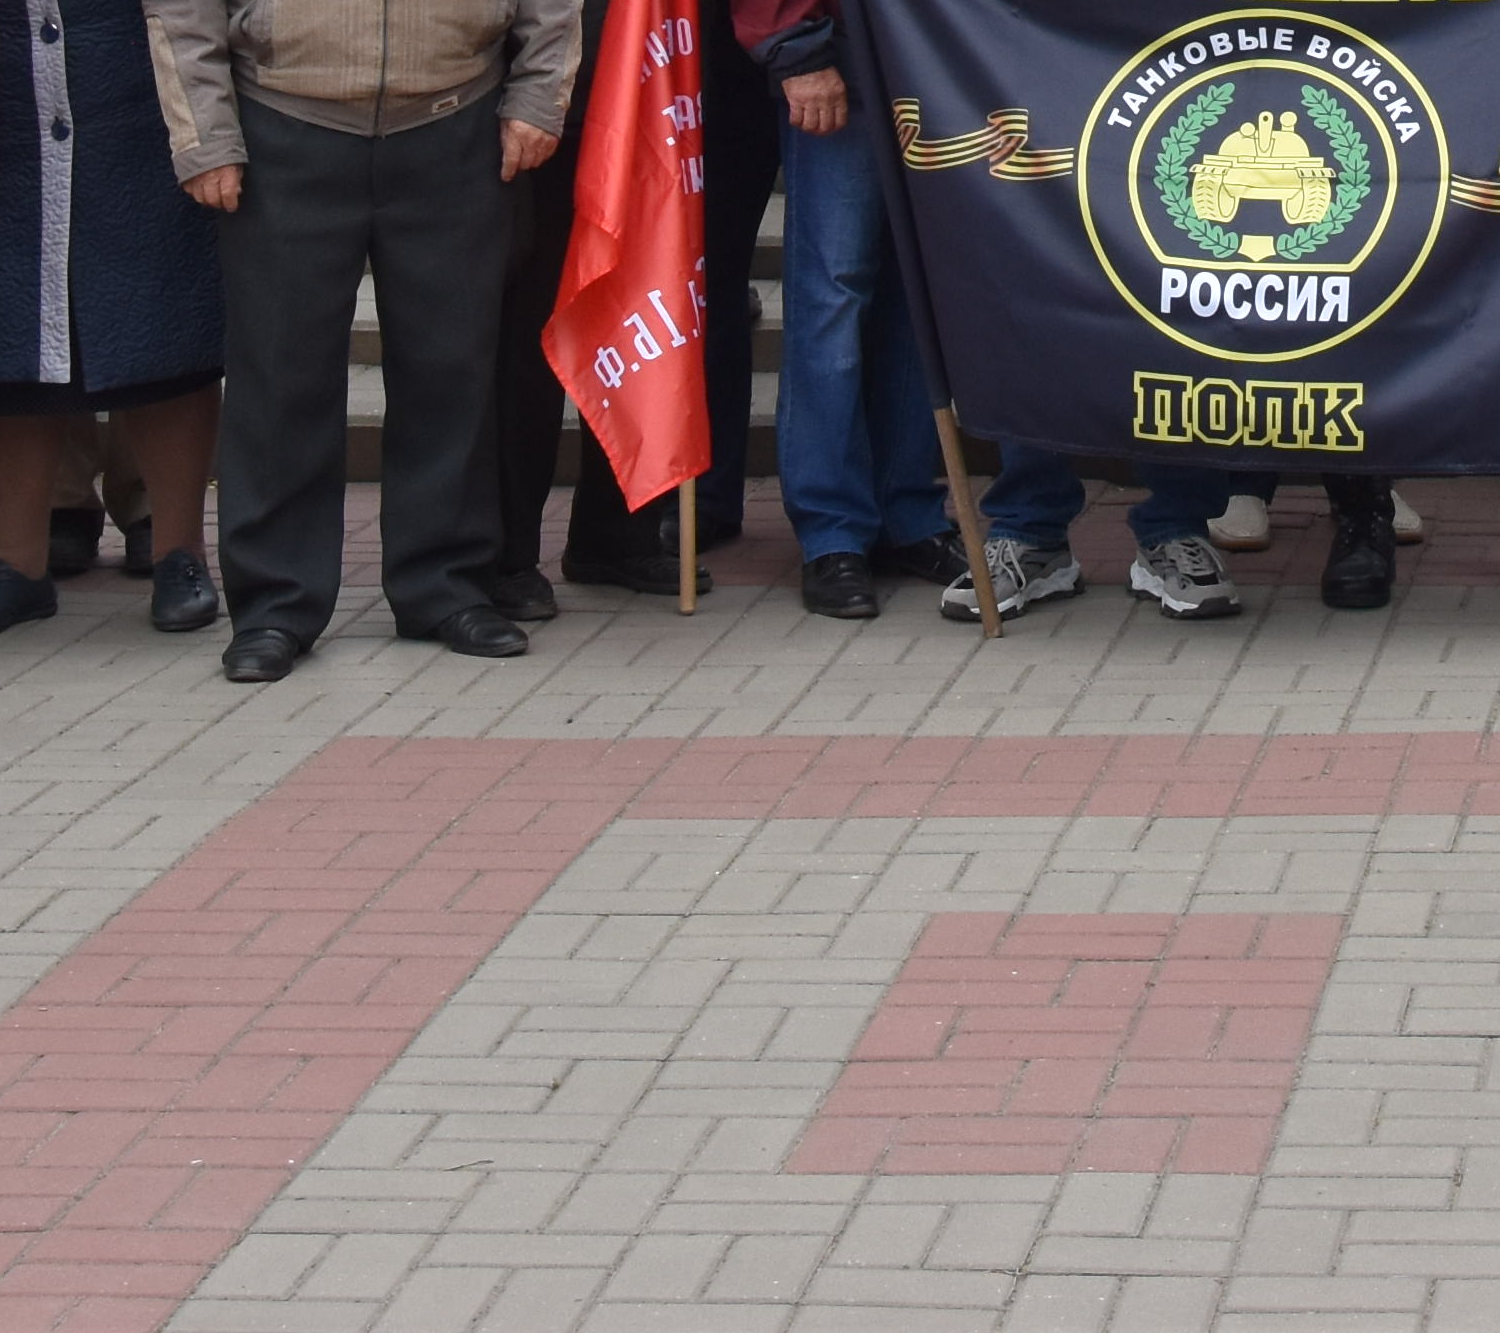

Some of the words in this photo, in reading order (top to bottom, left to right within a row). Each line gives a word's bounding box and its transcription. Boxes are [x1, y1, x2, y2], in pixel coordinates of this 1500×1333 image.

[1107, 26, 1295, 131] ТАНКОВЫЕ
[1306, 34, 1421, 144] ВОЙСКА
[1159, 268, 1351, 325] РОССИЯ
[1132, 372, 1365, 453] ПОЛК
